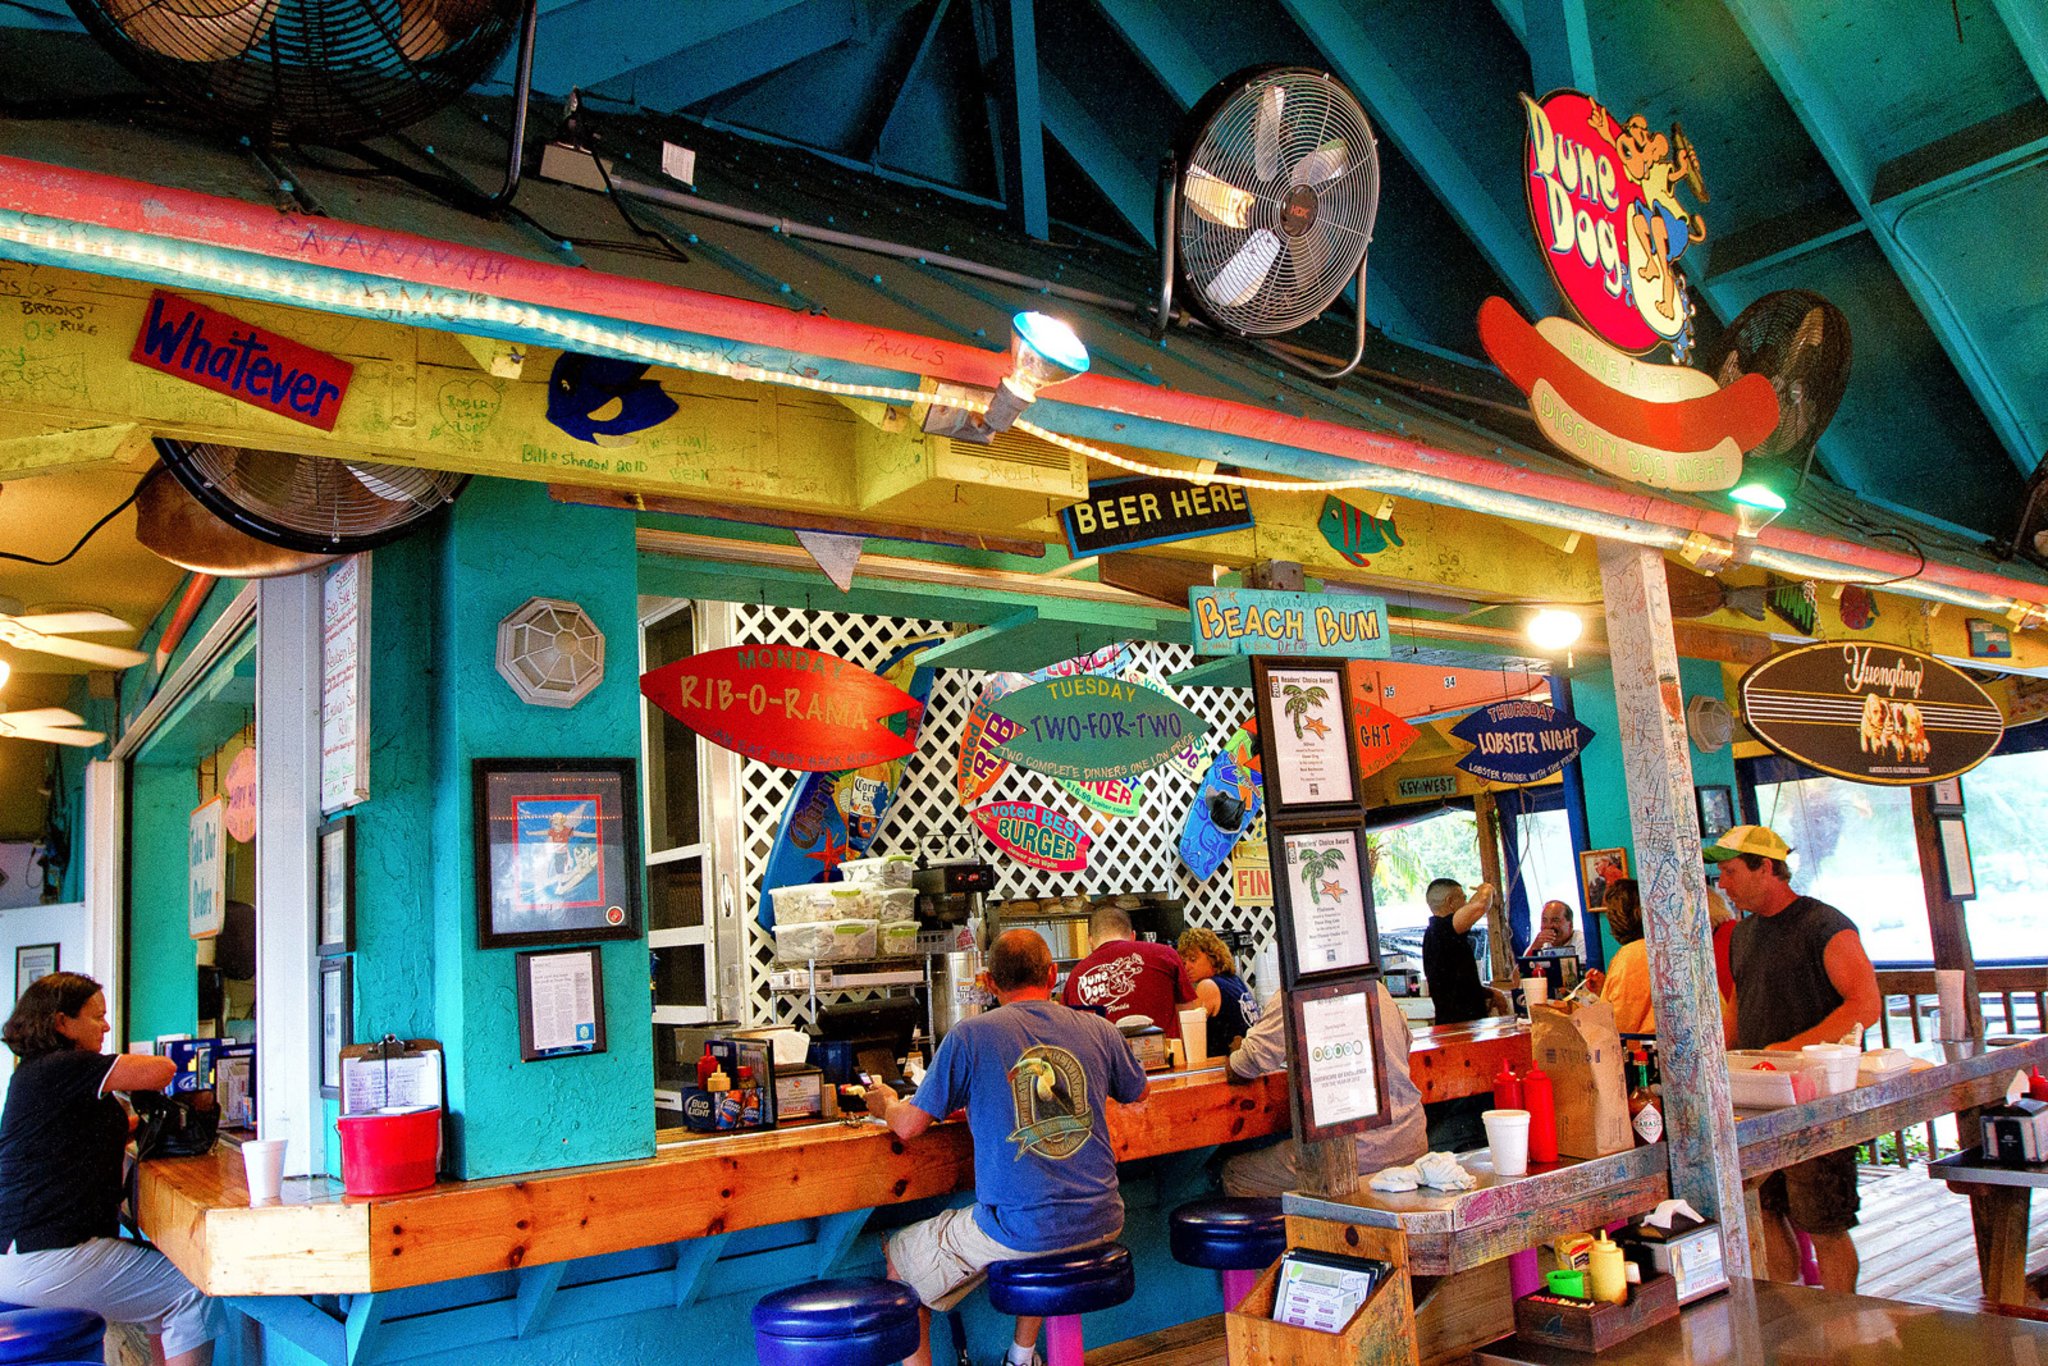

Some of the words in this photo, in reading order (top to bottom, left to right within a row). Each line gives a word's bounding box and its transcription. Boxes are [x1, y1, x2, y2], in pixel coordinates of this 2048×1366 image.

[1519, 91, 1621, 212] Dune
[1543, 173, 1624, 298] Dog
[143, 298, 340, 418] Whatever
[1569, 335, 1621, 384] HAVE
[1626, 364, 1640, 387] A
[1649, 368, 1684, 396] HOT
[1539, 391, 1620, 465] DIGGITY
[1628, 445, 1669, 482] DOG
[1676, 456, 1726, 483] NIGHT
[1074, 493, 1162, 534] BEER
[1170, 484, 1247, 519] HERE
[1196, 596, 1304, 641] BEACH
[1314, 606, 1381, 648] BUM
[738, 649, 846, 680] MONDAY
[1843, 643, 1925, 699] Yuengling
[1046, 678, 1137, 703] TUESDAY
[1384, 686, 1395, 697] 35
[1444, 676, 1456, 688] 34
[680, 675, 869, 731] RIB-O-RAMA
[1487, 701, 1556, 723] THURSDAY
[1030, 711, 1183, 743] TWO-FOR-TWO
[1477, 731, 1539, 755] LOBSTER
[1539, 727, 1579, 752] NIGHT
[999, 745, 1024, 763] TWO
[1025, 755, 1080, 779] COMPLETE
[1083, 766, 1128, 780] DINNERS
[1130, 759, 1151, 774] ONE
[1150, 750, 1170, 768] LOW
[1170, 731, 1197, 756] PRICE
[1468, 762, 1500, 780] LOBSTER
[1529, 769, 1547, 780] WITH
[1422, 778, 1455, 794] WEST
[990, 803, 1037, 820] voted
[1041, 809, 1087, 844] BEST
[997, 818, 1077, 860] BURGER
[1077, 971, 1109, 989] Dune
[1083, 983, 1107, 1001] Dog
[687, 1106, 710, 1118] LIGHT
[691, 1099, 709, 1110] BUD
